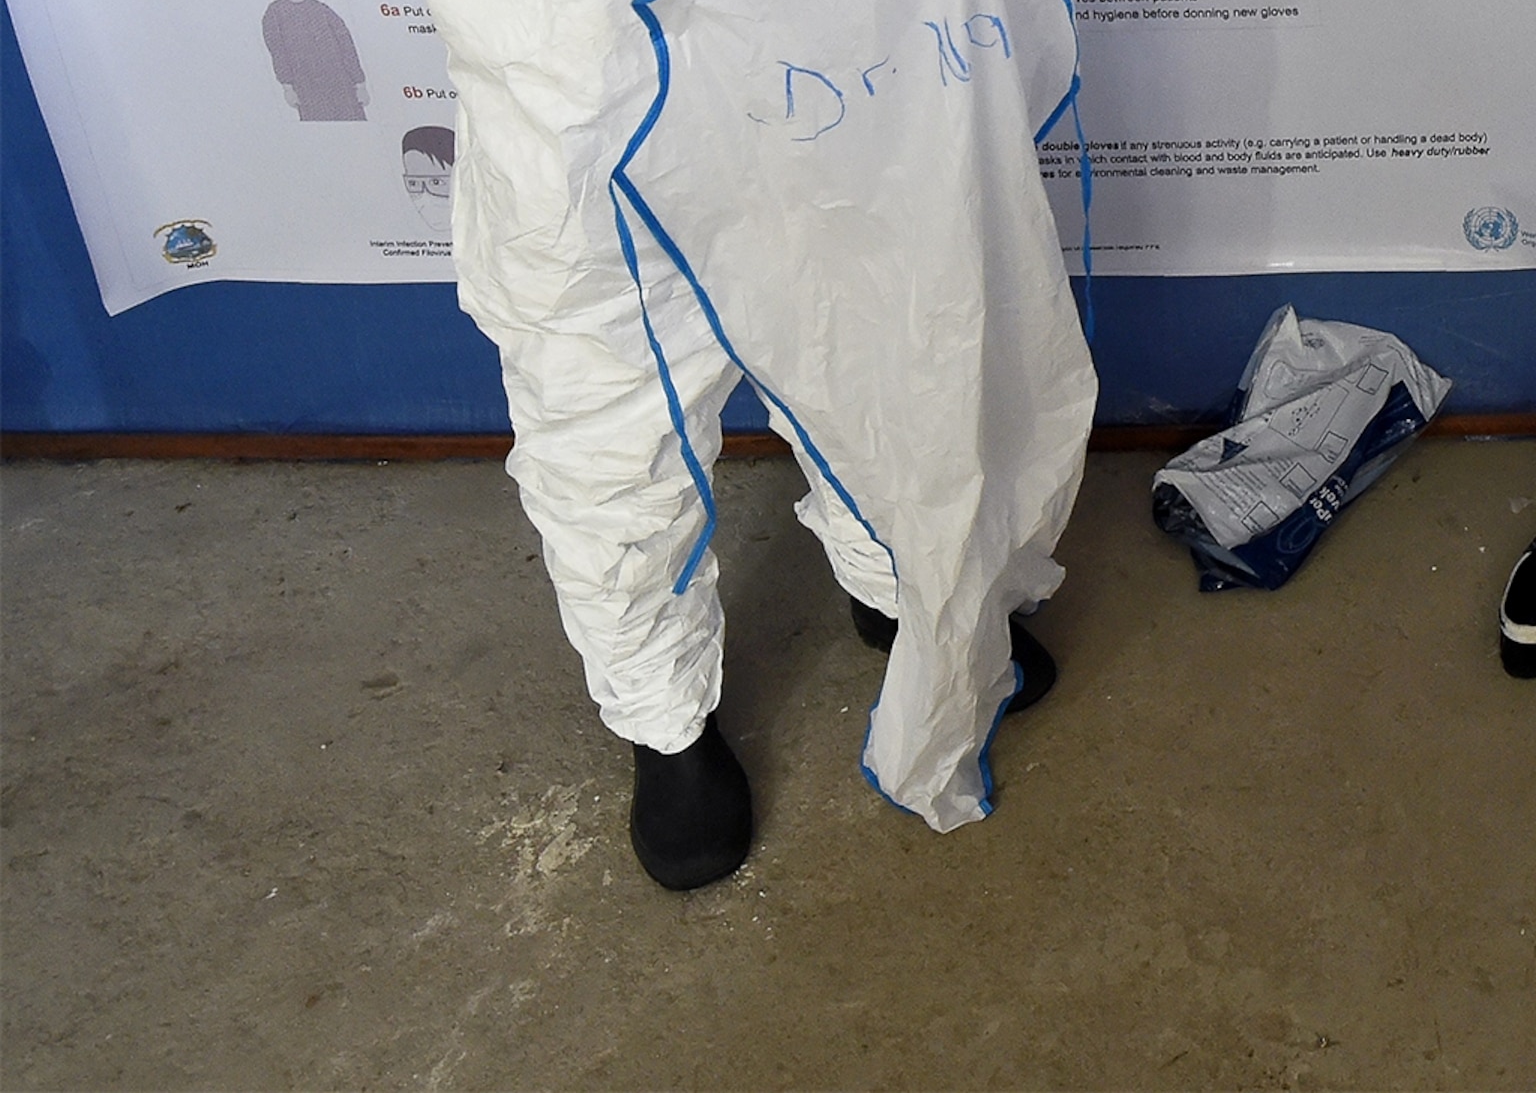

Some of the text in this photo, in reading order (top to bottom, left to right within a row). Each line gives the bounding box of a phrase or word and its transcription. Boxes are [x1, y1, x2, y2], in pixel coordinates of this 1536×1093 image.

[380, 3, 424, 17] 6a Put
[403, 86, 447, 99] 6b Put
[1042, 141, 1080, 151] double
